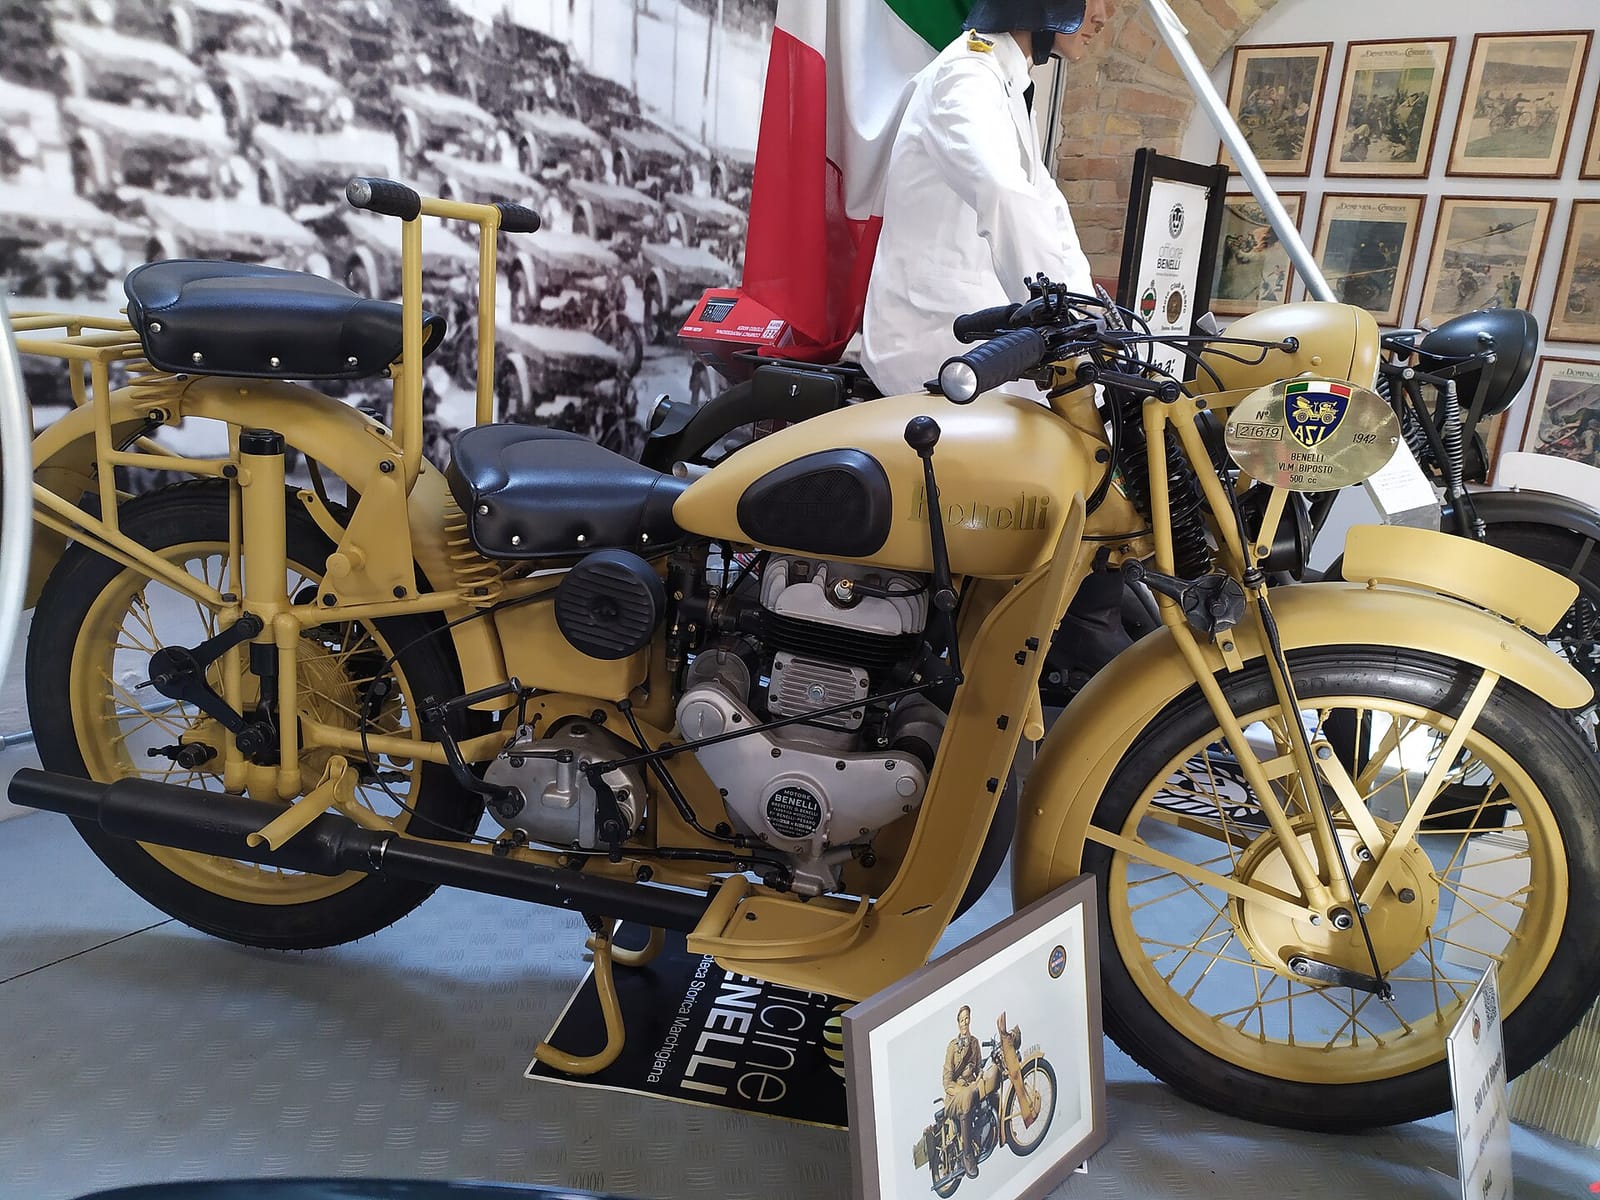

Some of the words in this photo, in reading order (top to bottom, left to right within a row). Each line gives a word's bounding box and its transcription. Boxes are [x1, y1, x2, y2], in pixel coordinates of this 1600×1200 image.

[1157, 258, 1181, 270] BENELLI
[1239, 426, 1280, 439] 21619
[1294, 425, 1326, 445] ASI
[1352, 433, 1377, 445] 1942
[1291, 452, 1324, 462] BENELLI
[1279, 462, 1294, 472] VLM
[1298, 464, 1333, 474] BIPOSTO
[1289, 475, 1303, 483] 500
[784, 790, 811, 800] MOTORE
[775, 794, 817, 811] BENELLI
[679, 981, 706, 1015] Storica
[647, 1016, 691, 1084] Marchigiana
